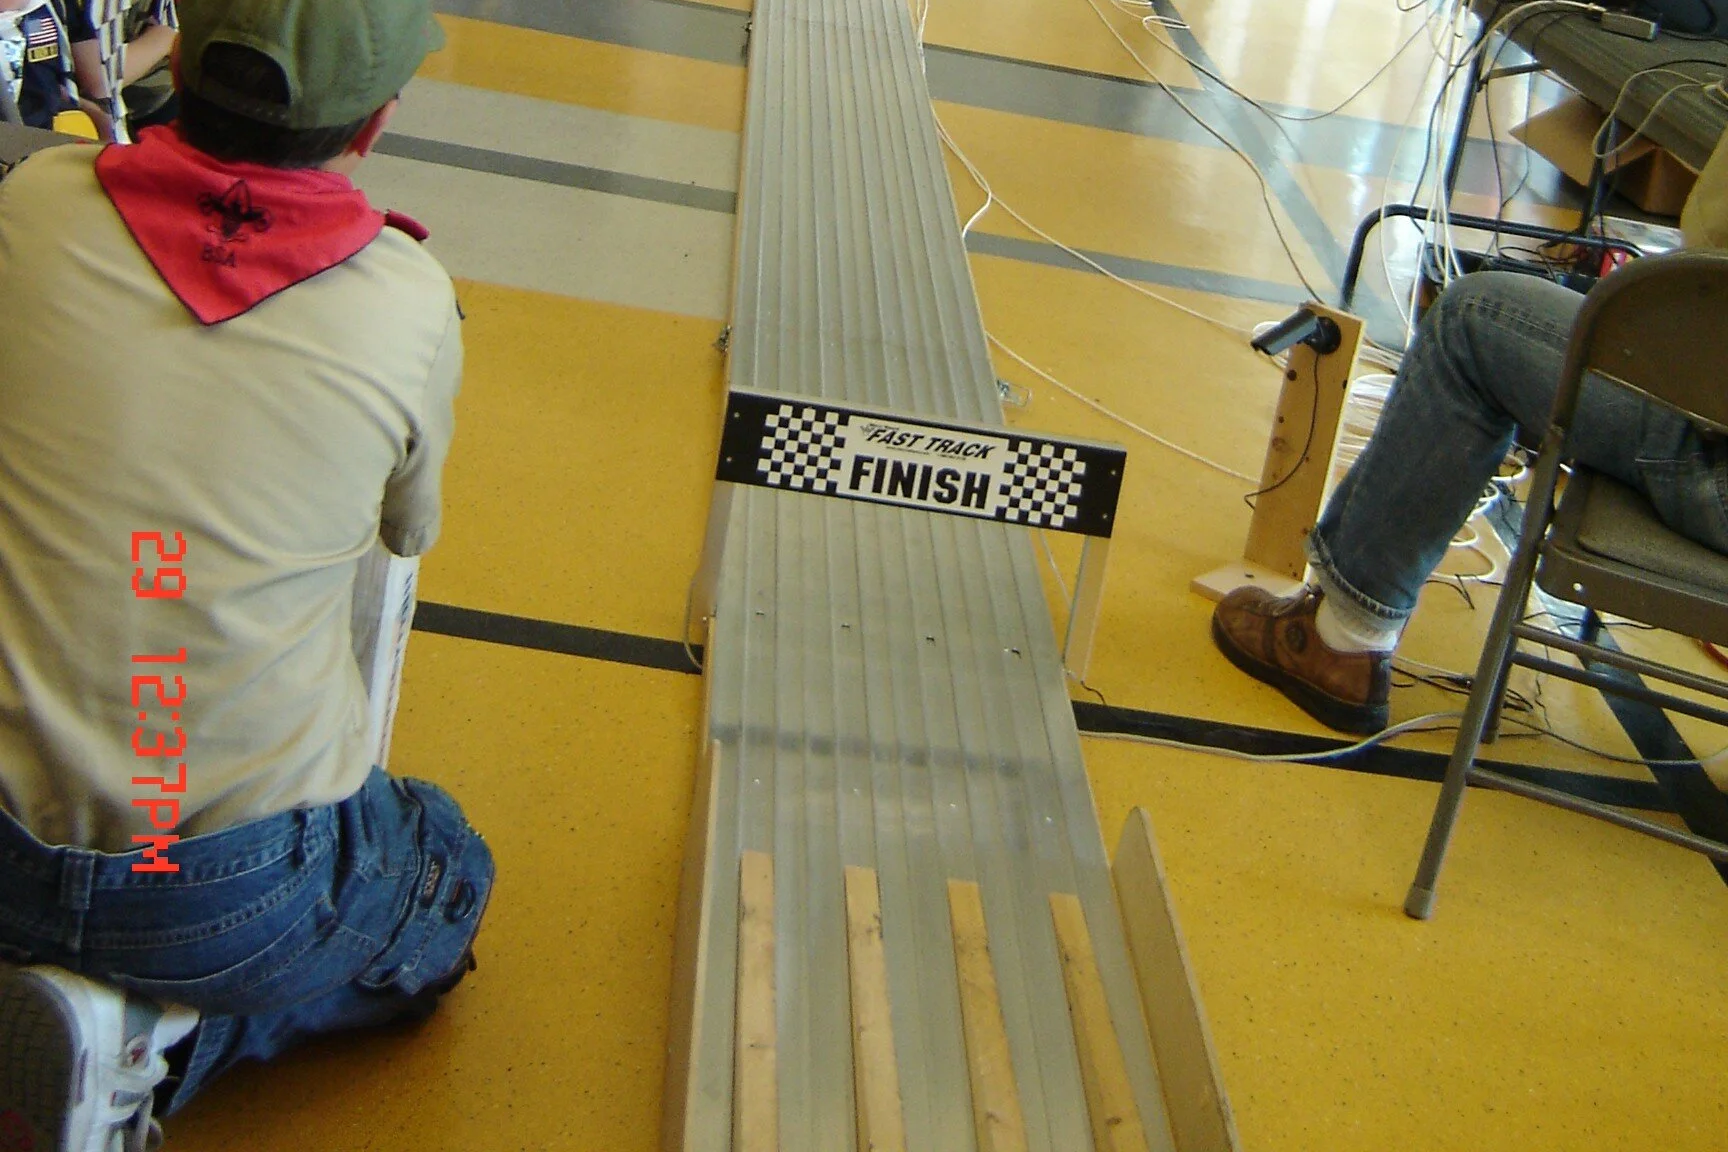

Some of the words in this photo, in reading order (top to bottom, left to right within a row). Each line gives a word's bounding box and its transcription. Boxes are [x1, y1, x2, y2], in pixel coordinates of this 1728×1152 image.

[866, 428, 925, 448] FAST
[924, 436, 997, 460] TRACK
[849, 453, 991, 510] FINISH
